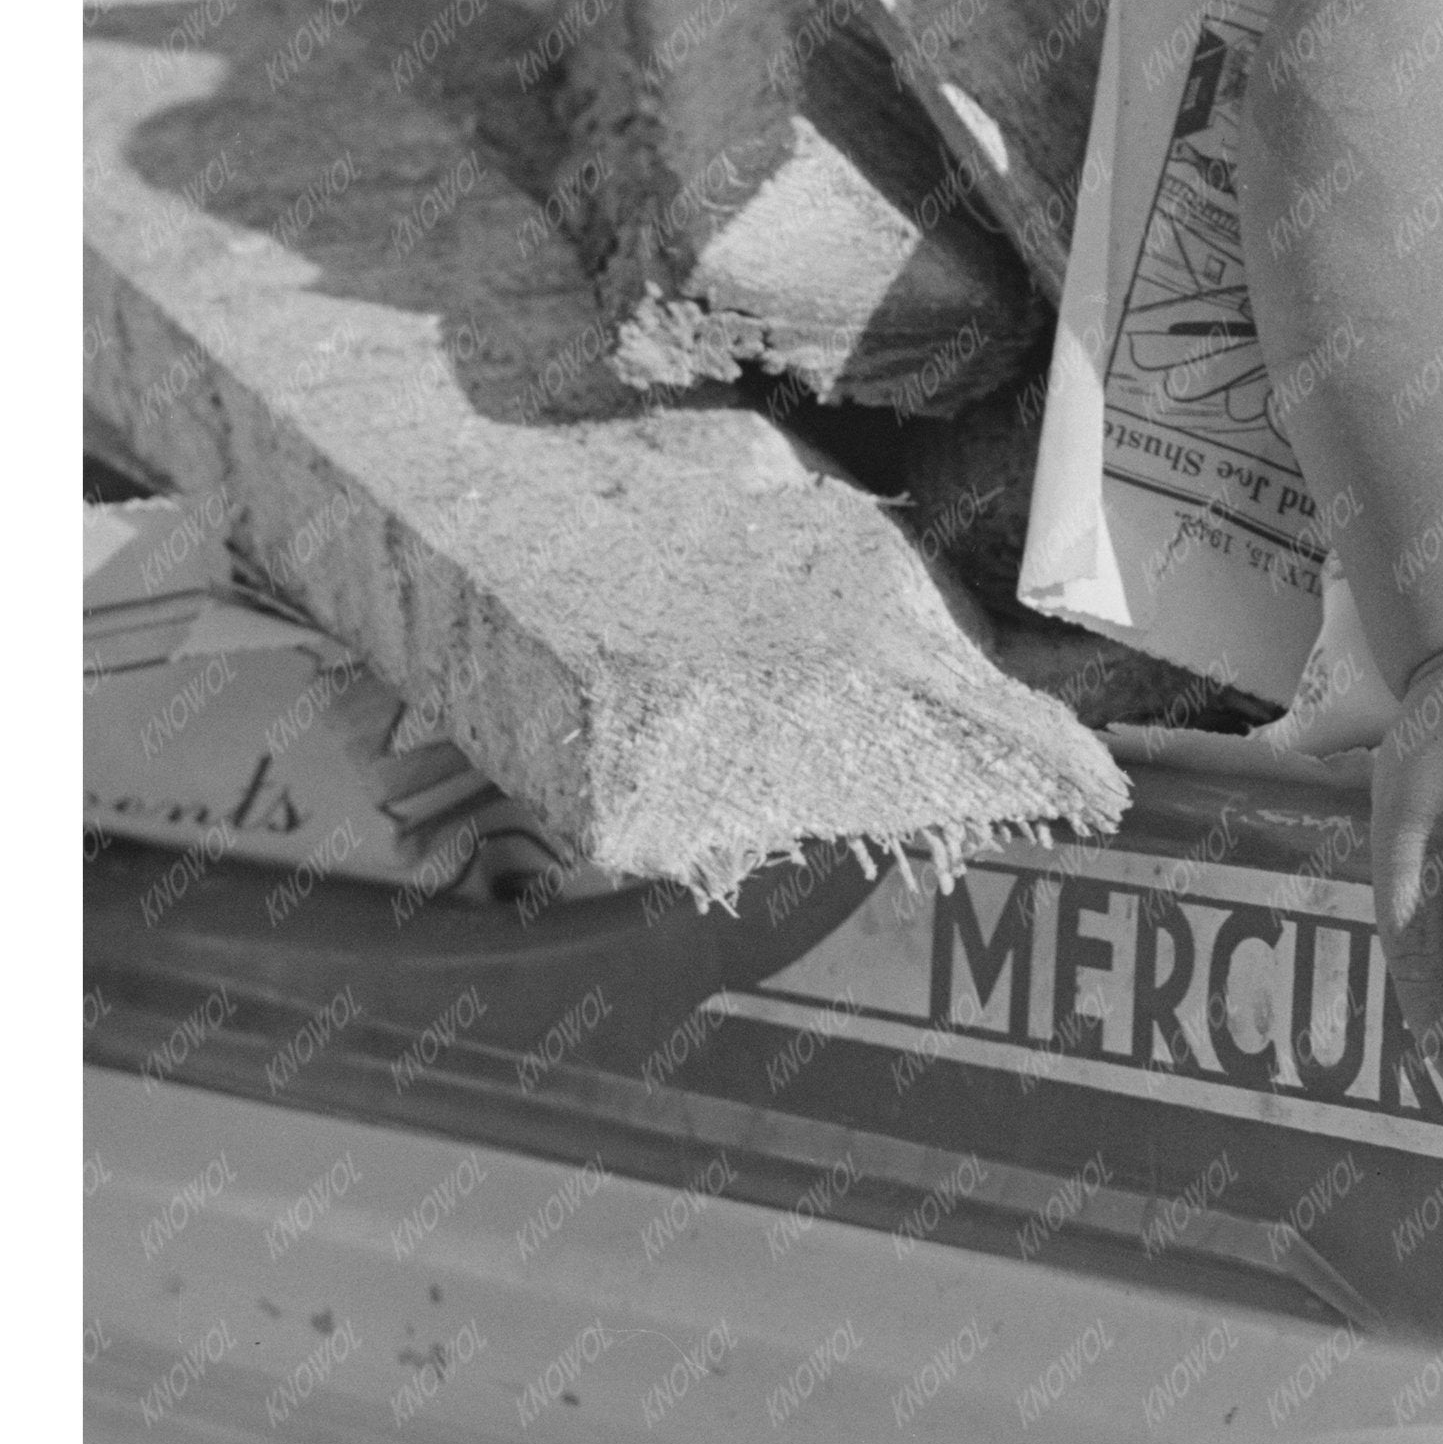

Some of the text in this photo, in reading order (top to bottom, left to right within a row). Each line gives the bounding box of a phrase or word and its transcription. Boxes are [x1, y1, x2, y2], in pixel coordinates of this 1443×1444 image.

[1103, 419, 1317, 518] nd Joe Shuste
[1282, 565, 1323, 599] LY
